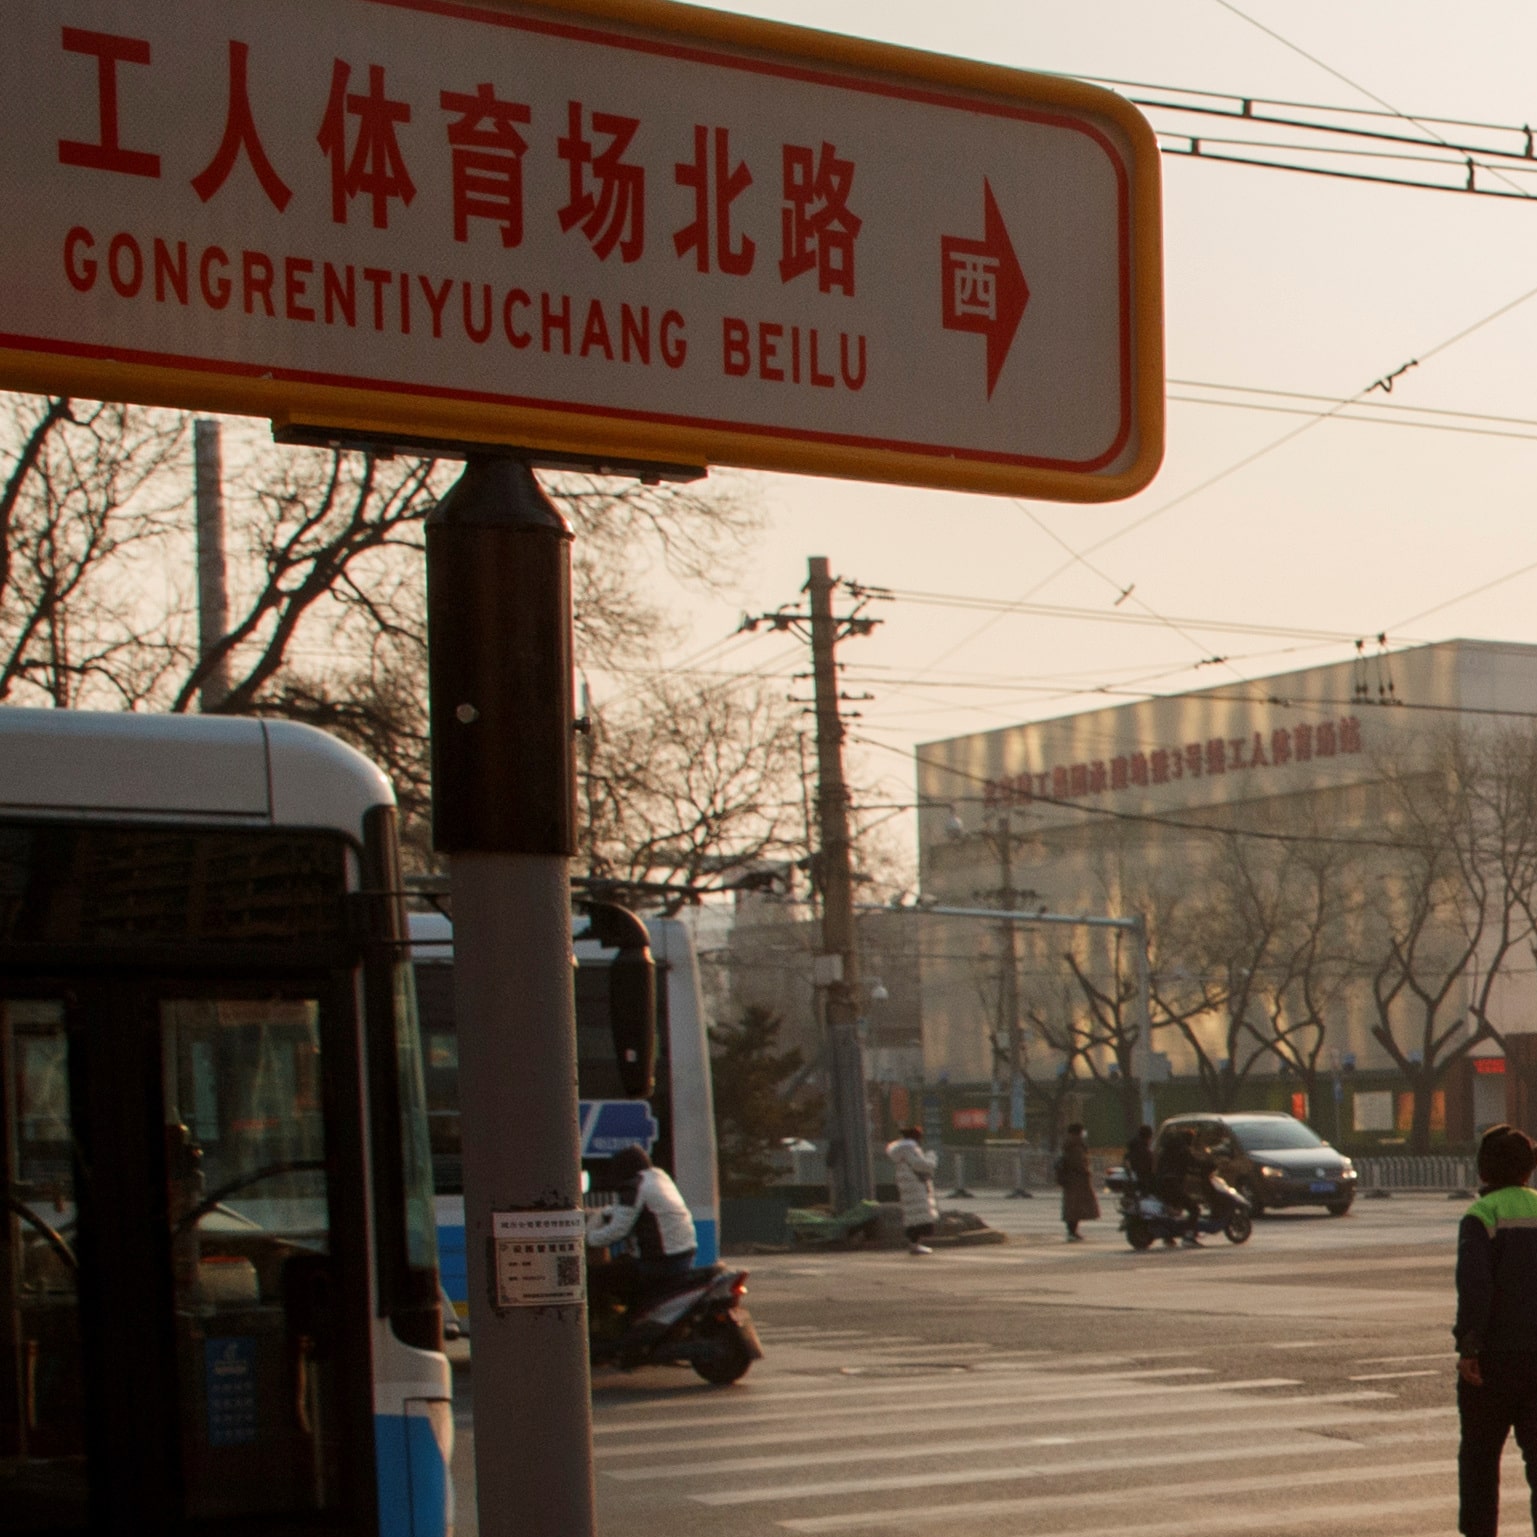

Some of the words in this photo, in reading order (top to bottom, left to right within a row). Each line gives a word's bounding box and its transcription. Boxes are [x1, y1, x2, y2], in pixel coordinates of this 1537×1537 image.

[58, 26, 863, 298] 工人体育场北路
[63, 225, 689, 369] GONGRENTIYUCHANG
[722, 316, 868, 392] BEILU
[951, 250, 999, 321] 西
